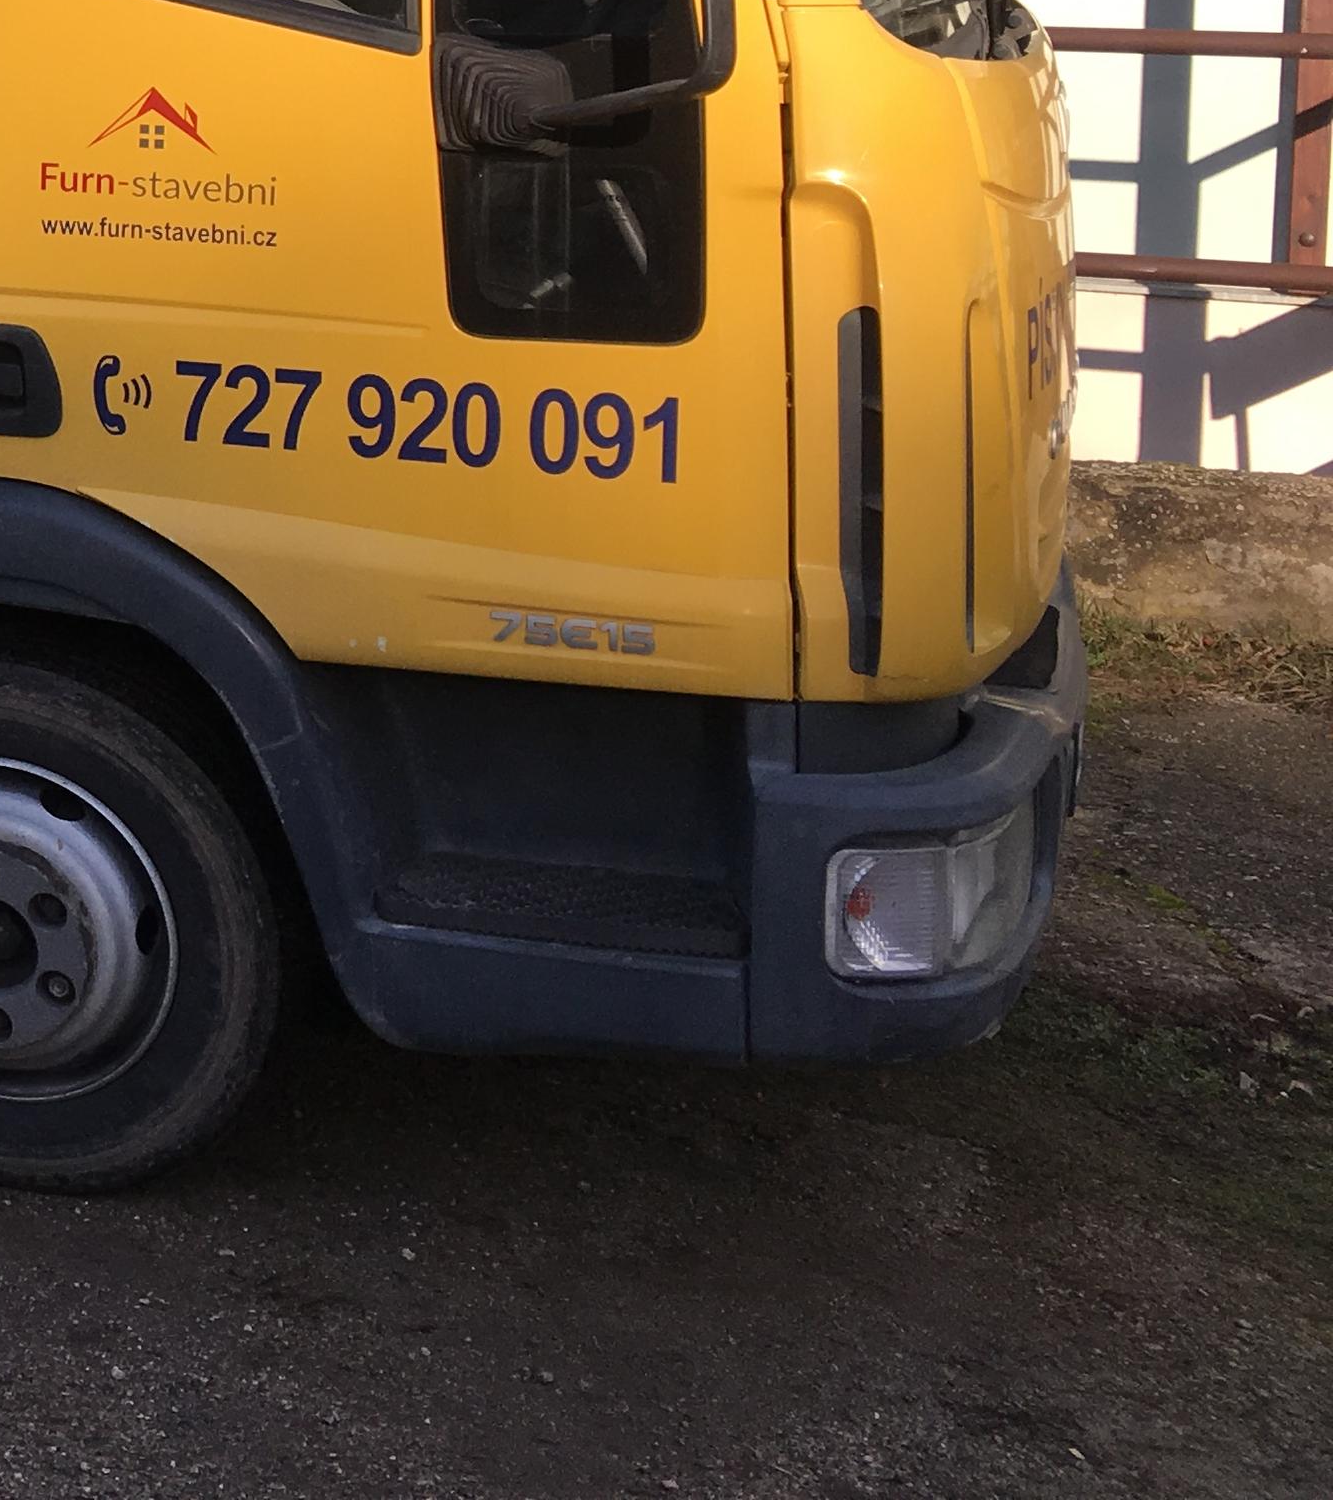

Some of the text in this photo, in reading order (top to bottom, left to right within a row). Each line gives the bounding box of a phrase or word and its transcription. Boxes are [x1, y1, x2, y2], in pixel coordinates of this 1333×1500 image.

[39, 162, 277, 206] Furn-stavebni
[41, 216, 277, 247] www.furn-stavebni.cz
[175, 360, 680, 484] 727 920 091
